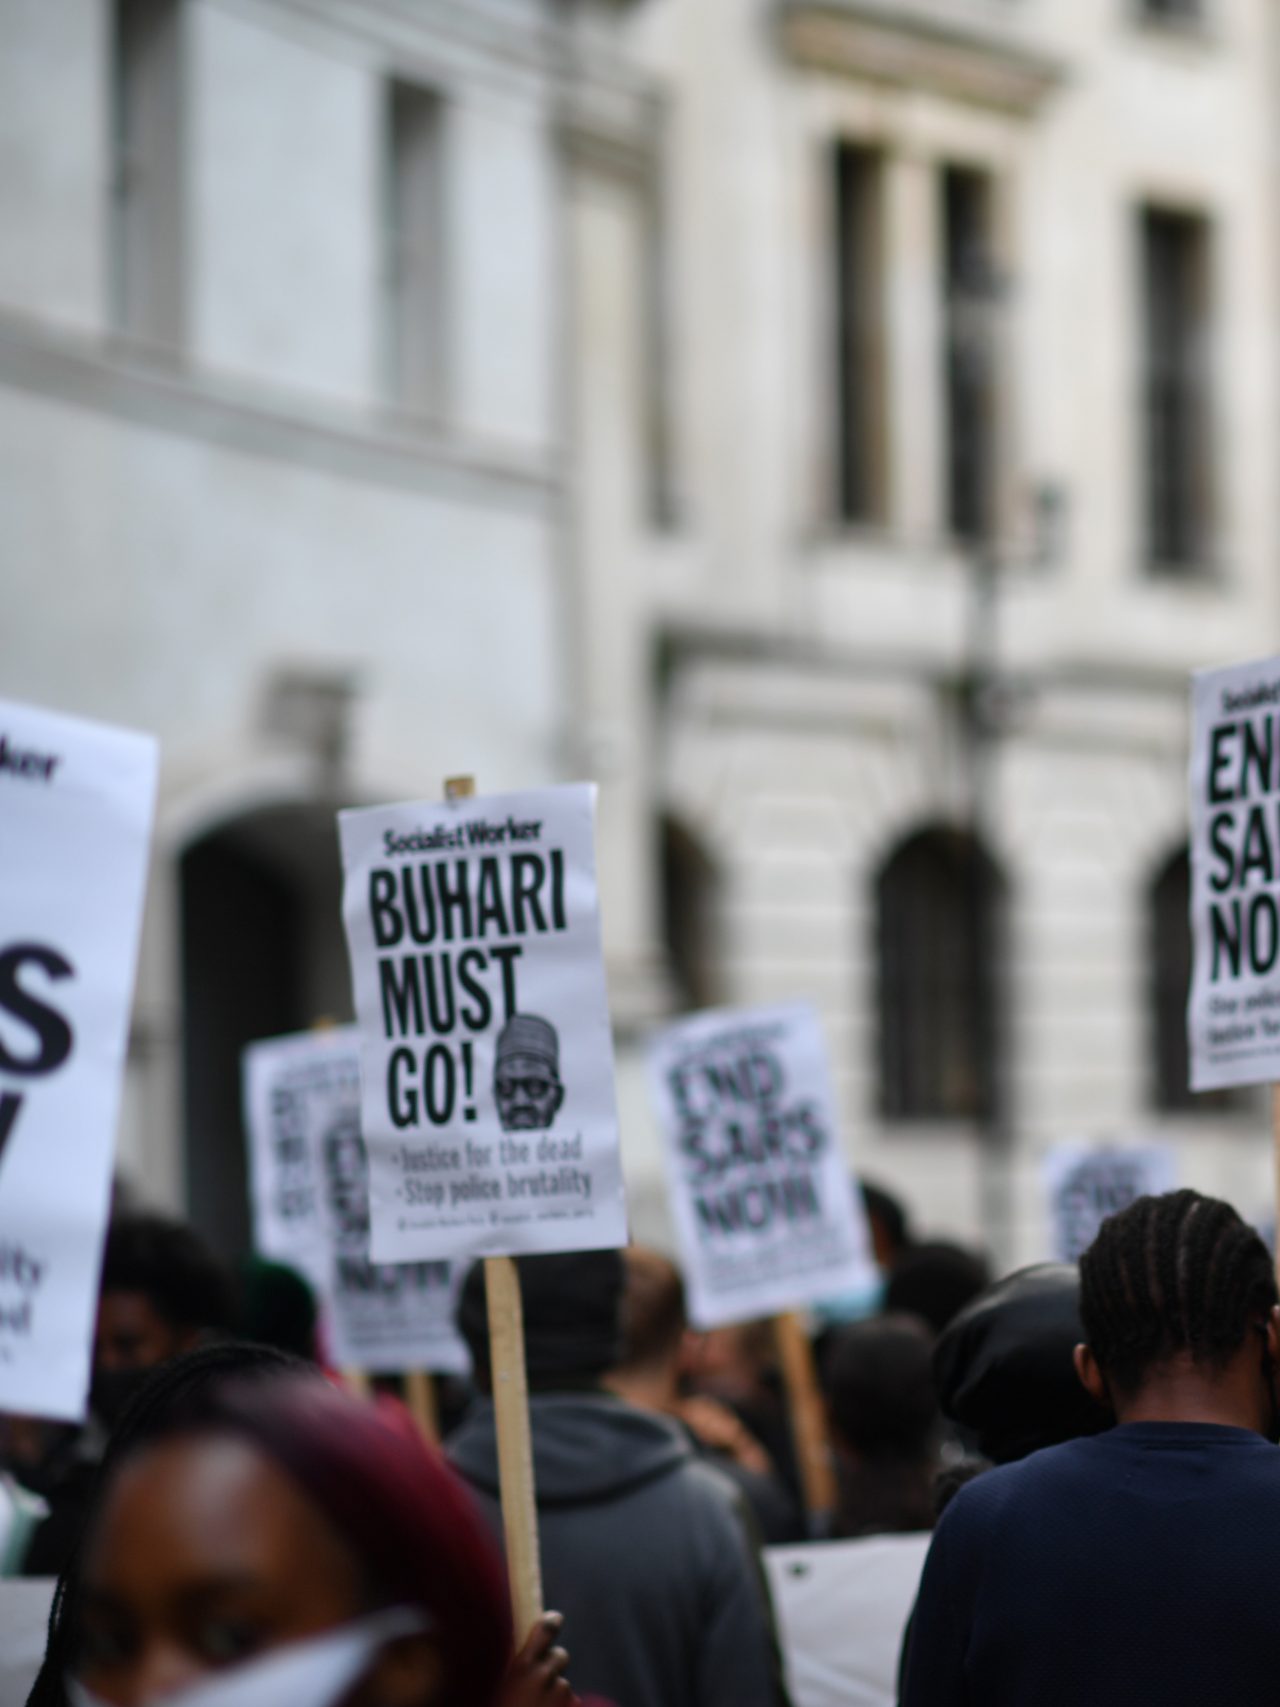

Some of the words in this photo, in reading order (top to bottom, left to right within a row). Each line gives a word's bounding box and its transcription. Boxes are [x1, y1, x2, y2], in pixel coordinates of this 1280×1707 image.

[368, 848, 568, 948] BUHARI
[378, 945, 523, 1040] MUST
[386, 1041, 477, 1131] GO!
[450, 1174, 501, 1208] police
[505, 1167, 592, 1199] brutality
[465, 1138, 491, 1167] for
[500, 1136, 530, 1165] the
[536, 1131, 583, 1161] dead
